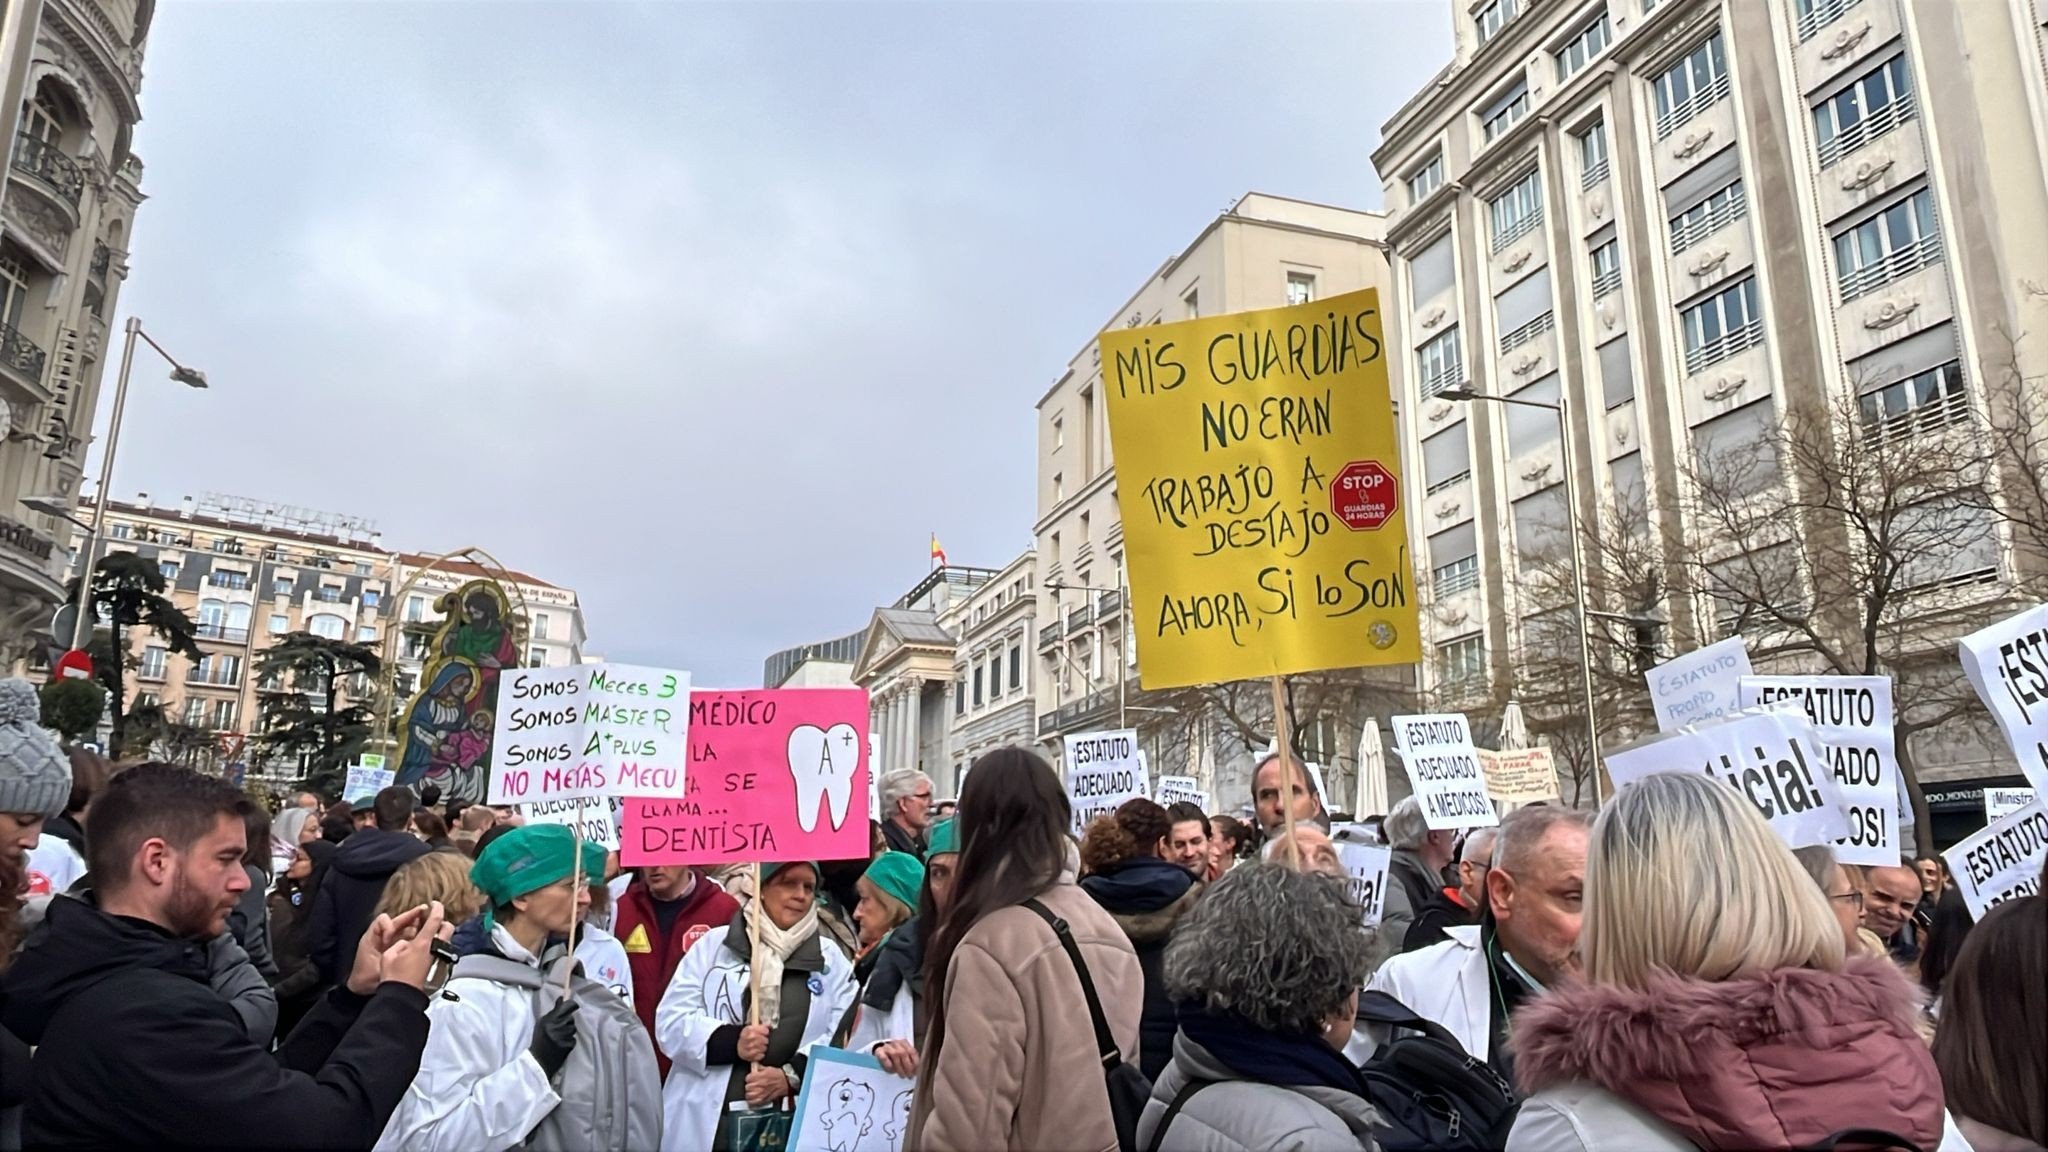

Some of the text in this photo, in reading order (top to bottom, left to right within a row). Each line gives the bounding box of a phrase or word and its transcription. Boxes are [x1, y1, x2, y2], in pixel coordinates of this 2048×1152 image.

[1116, 309, 1380, 398] MIS GUARDIAS
[1202, 389, 1331, 451] NO ERAN
[1142, 456, 1325, 528] TRABAJO A
[1342, 474, 1385, 490] STOP
[1343, 503, 1386, 513] GUARDIAS
[1356, 511, 1386, 519] HORAS
[1193, 500, 1329, 557] DESTAJO
[1326, 546, 1405, 618] SON
[657, 675, 677, 698] 3
[1658, 656, 1736, 696] ESTATUTO
[1998, 628, 2048, 725] ¡EST
[689, 695, 777, 726] MÉDICO
[1757, 687, 1874, 727] ATUTO
[693, 743, 717, 762] LA
[1406, 720, 1463, 753] ¡ESTATUTO
[1073, 737, 1130, 770] ¡ESTATUTO
[1415, 755, 1477, 781] ADECUADO
[502, 770, 529, 798] NO
[725, 773, 758, 792] SE
[1074, 770, 1133, 798] ADECUADO
[1427, 786, 1490, 819] A MÉDICOS!
[642, 821, 777, 853] DENTISTA
[1965, 812, 2048, 897] ¡ESTATUTO
